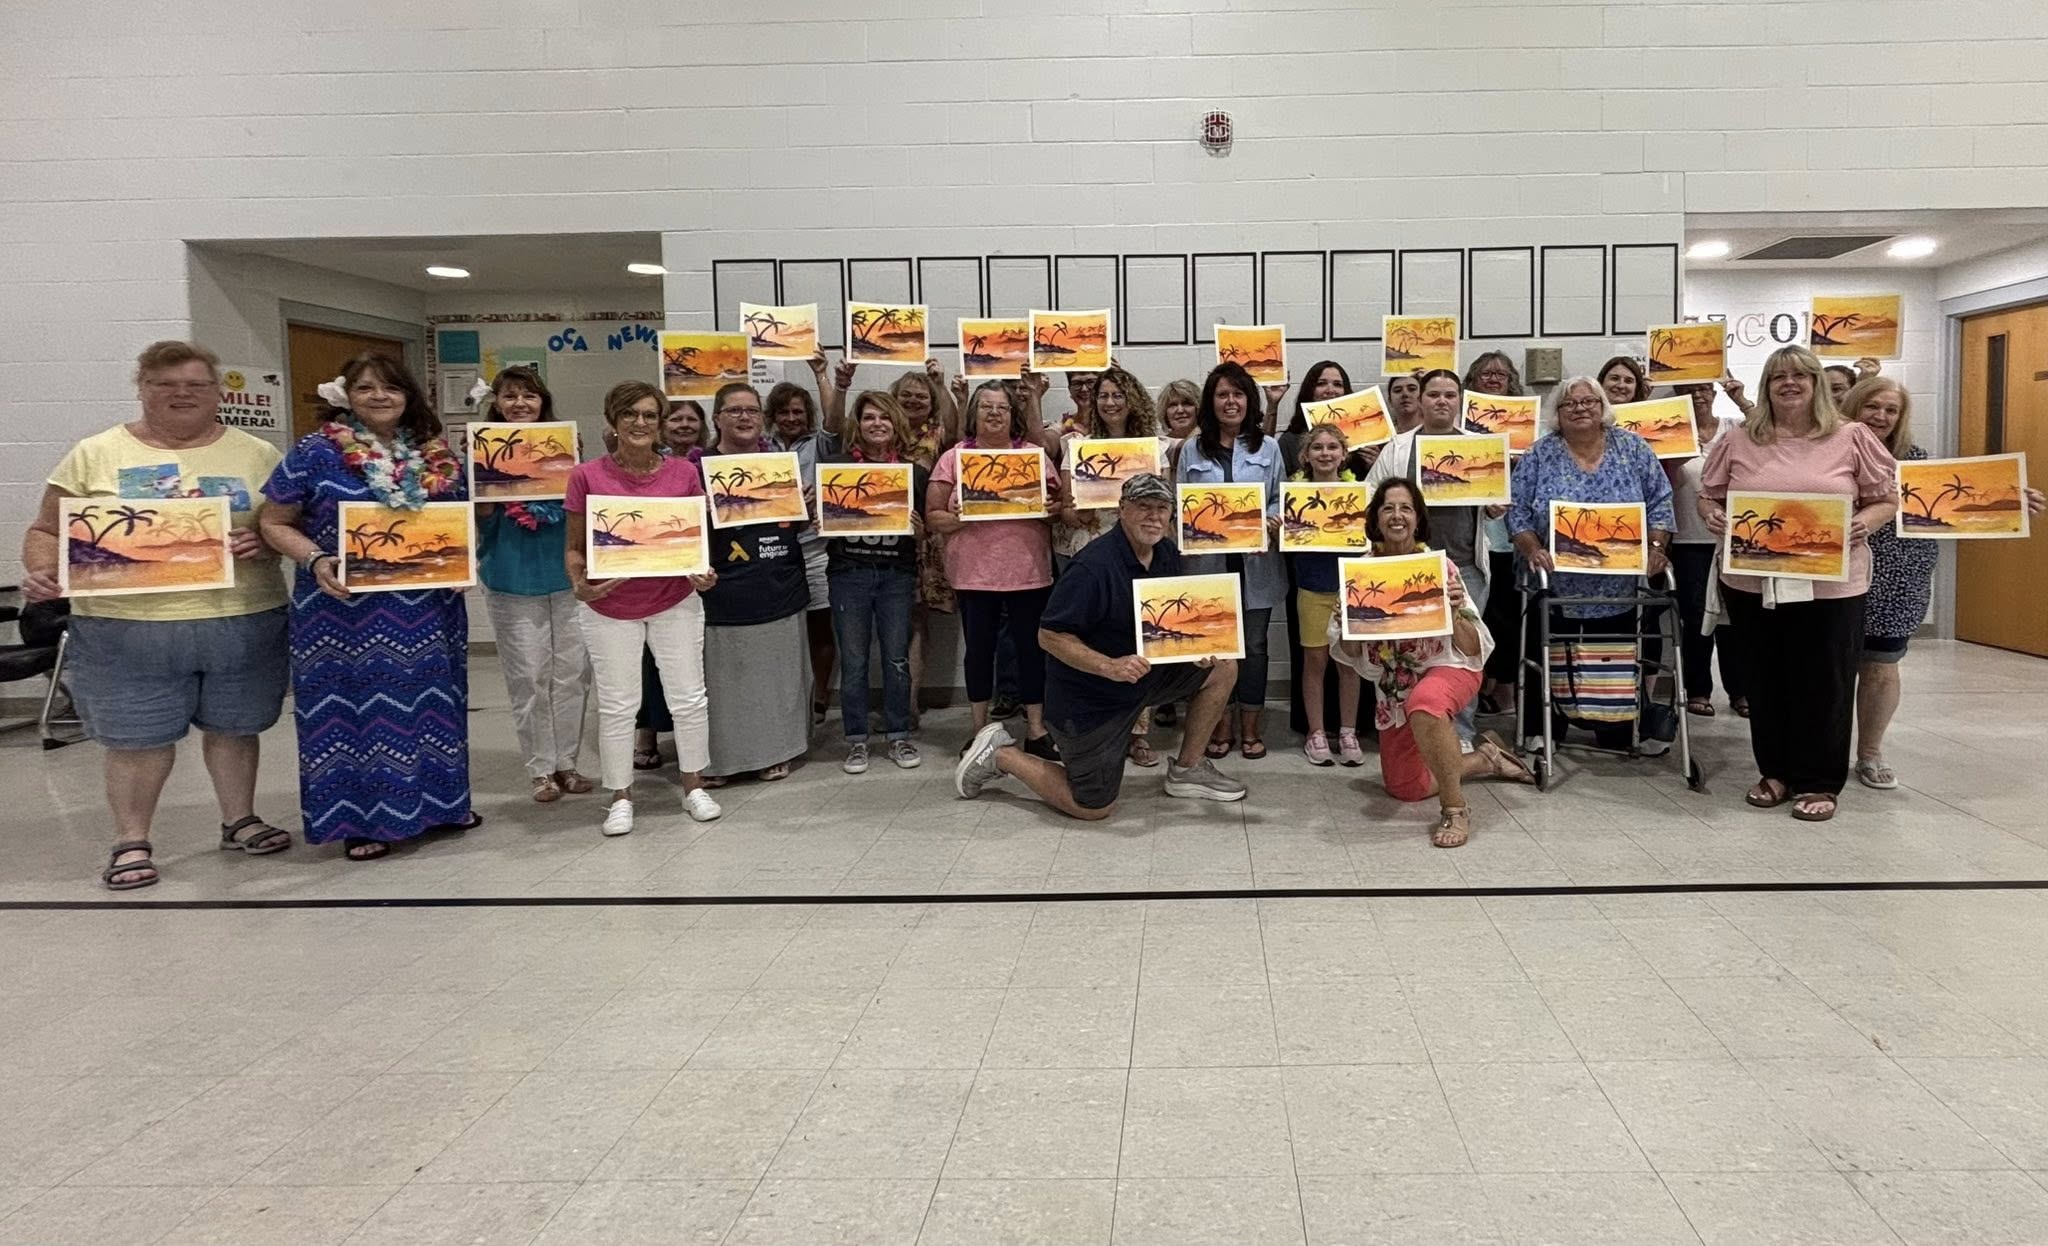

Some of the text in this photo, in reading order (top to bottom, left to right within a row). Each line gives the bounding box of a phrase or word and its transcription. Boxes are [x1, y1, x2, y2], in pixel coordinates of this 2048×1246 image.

[548, 328, 588, 352] OCA
[218, 392, 271, 407] MILE!
[216, 407, 250, 415] ou're
[215, 415, 275, 428] AMERA!
